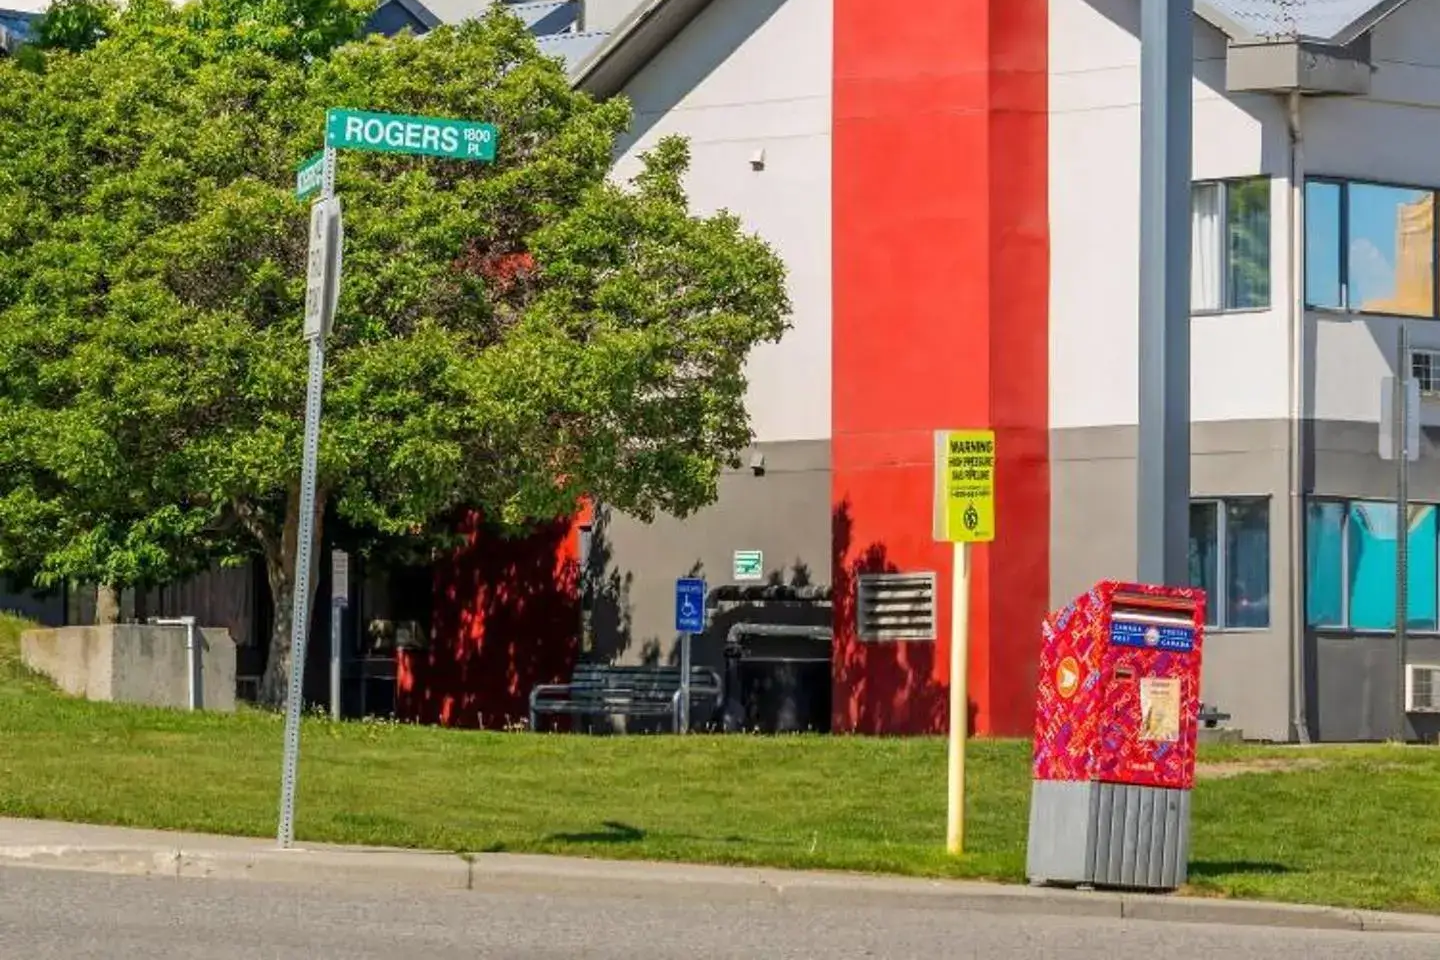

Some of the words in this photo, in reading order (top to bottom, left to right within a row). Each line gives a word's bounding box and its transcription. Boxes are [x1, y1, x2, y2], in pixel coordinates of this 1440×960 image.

[345, 116, 459, 152] ROGERS
[463, 128, 490, 142] 1800
[468, 143, 482, 156] PL
